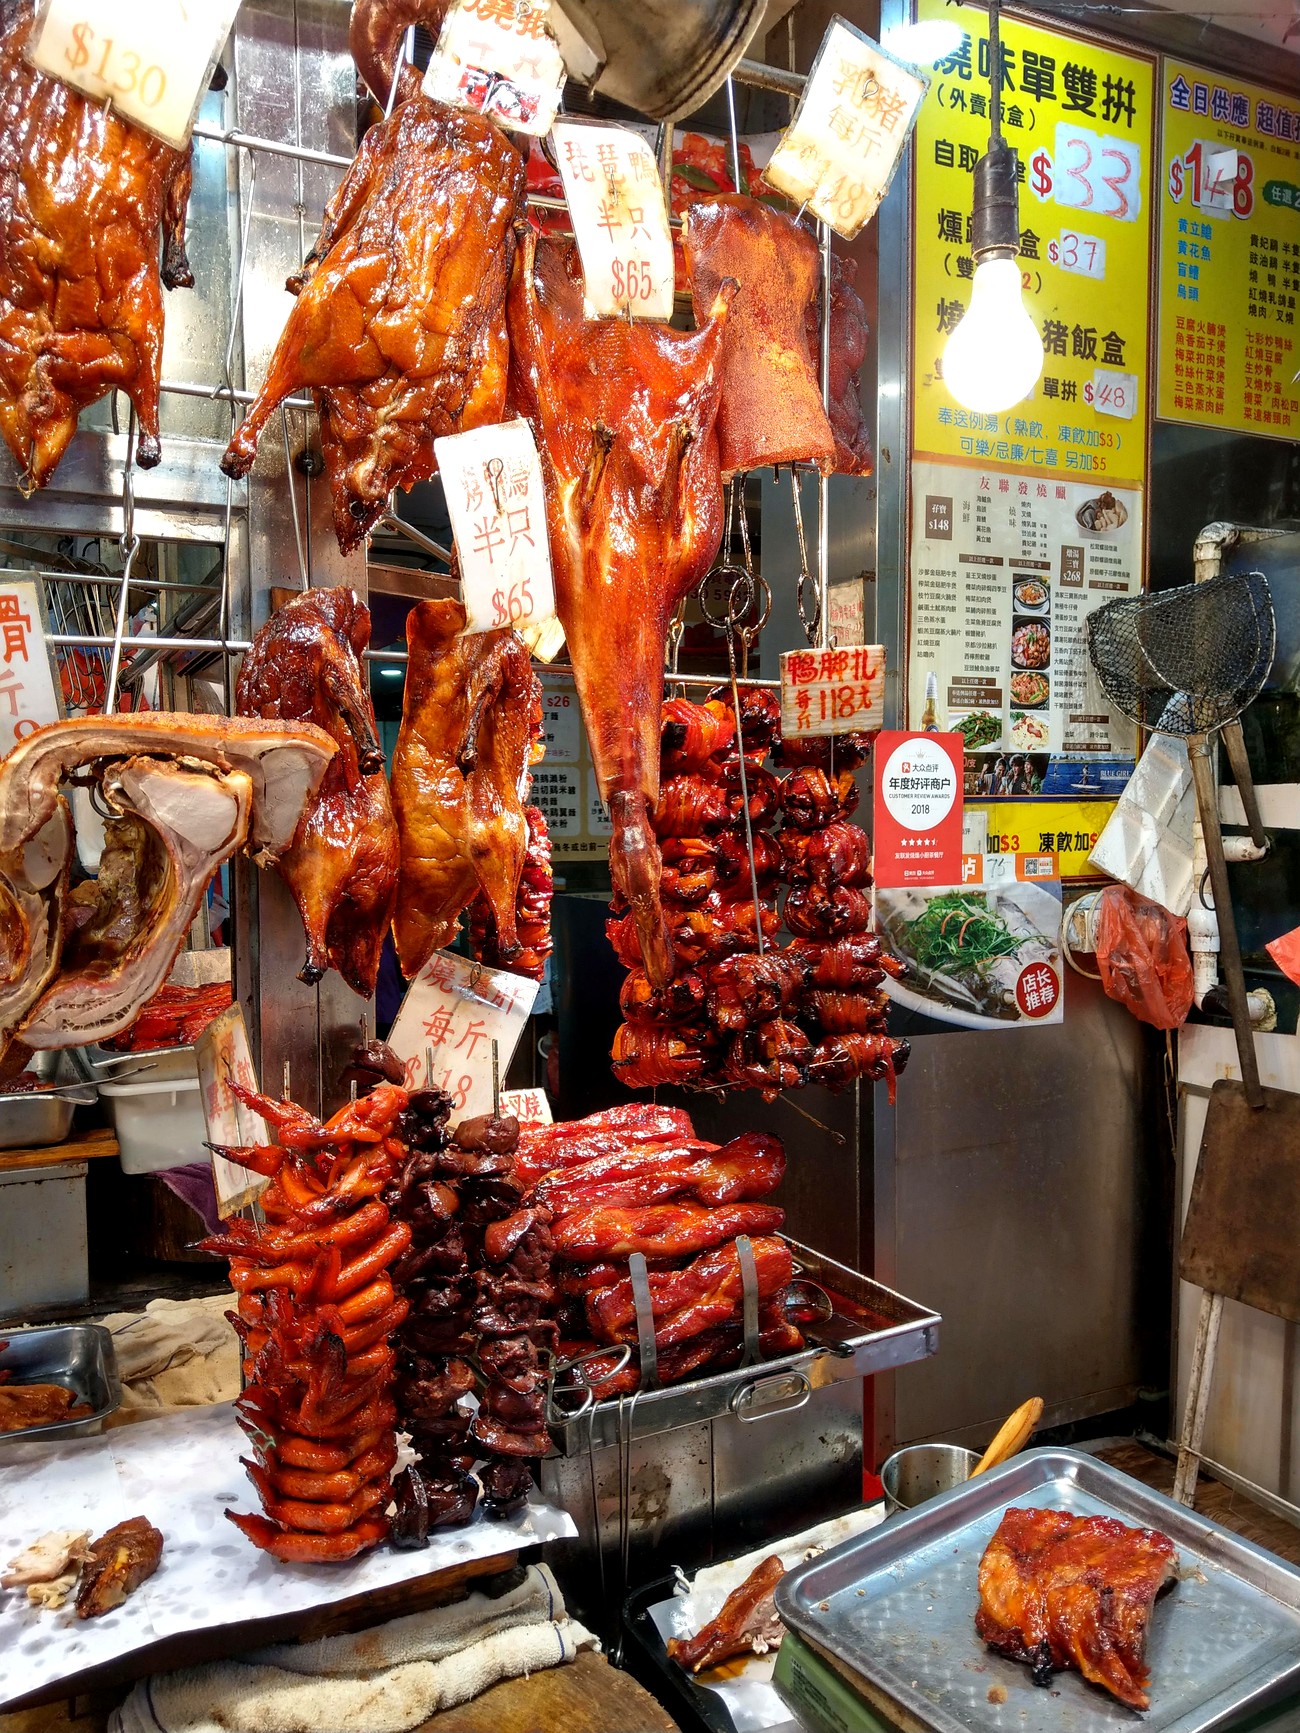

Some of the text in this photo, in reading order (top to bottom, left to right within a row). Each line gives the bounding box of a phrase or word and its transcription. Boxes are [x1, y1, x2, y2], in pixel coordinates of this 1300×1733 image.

[65, 22, 167, 107] $130
[1171, 75, 1250, 128] 全日供應
[1032, 139, 1132, 218] $33
[597, 199, 652, 243] 半只
[1048, 233, 1097, 271] $37
[611, 256, 652, 301] $65
[1084, 382, 1126, 408] $48
[473, 506, 535, 564] 半只
[928, 518, 950, 531] $148
[1063, 570, 1082, 582] $268
[491, 577, 535, 629] $65
[889, 777, 951, 791] 年度好评商户
[912, 763, 939, 773] 大众点评
[911, 804, 930, 815] 2018
[1022, 967, 1052, 994] 店长
[1025, 986, 1055, 1012] 推荐
[422, 1005, 488, 1060] 每斤
